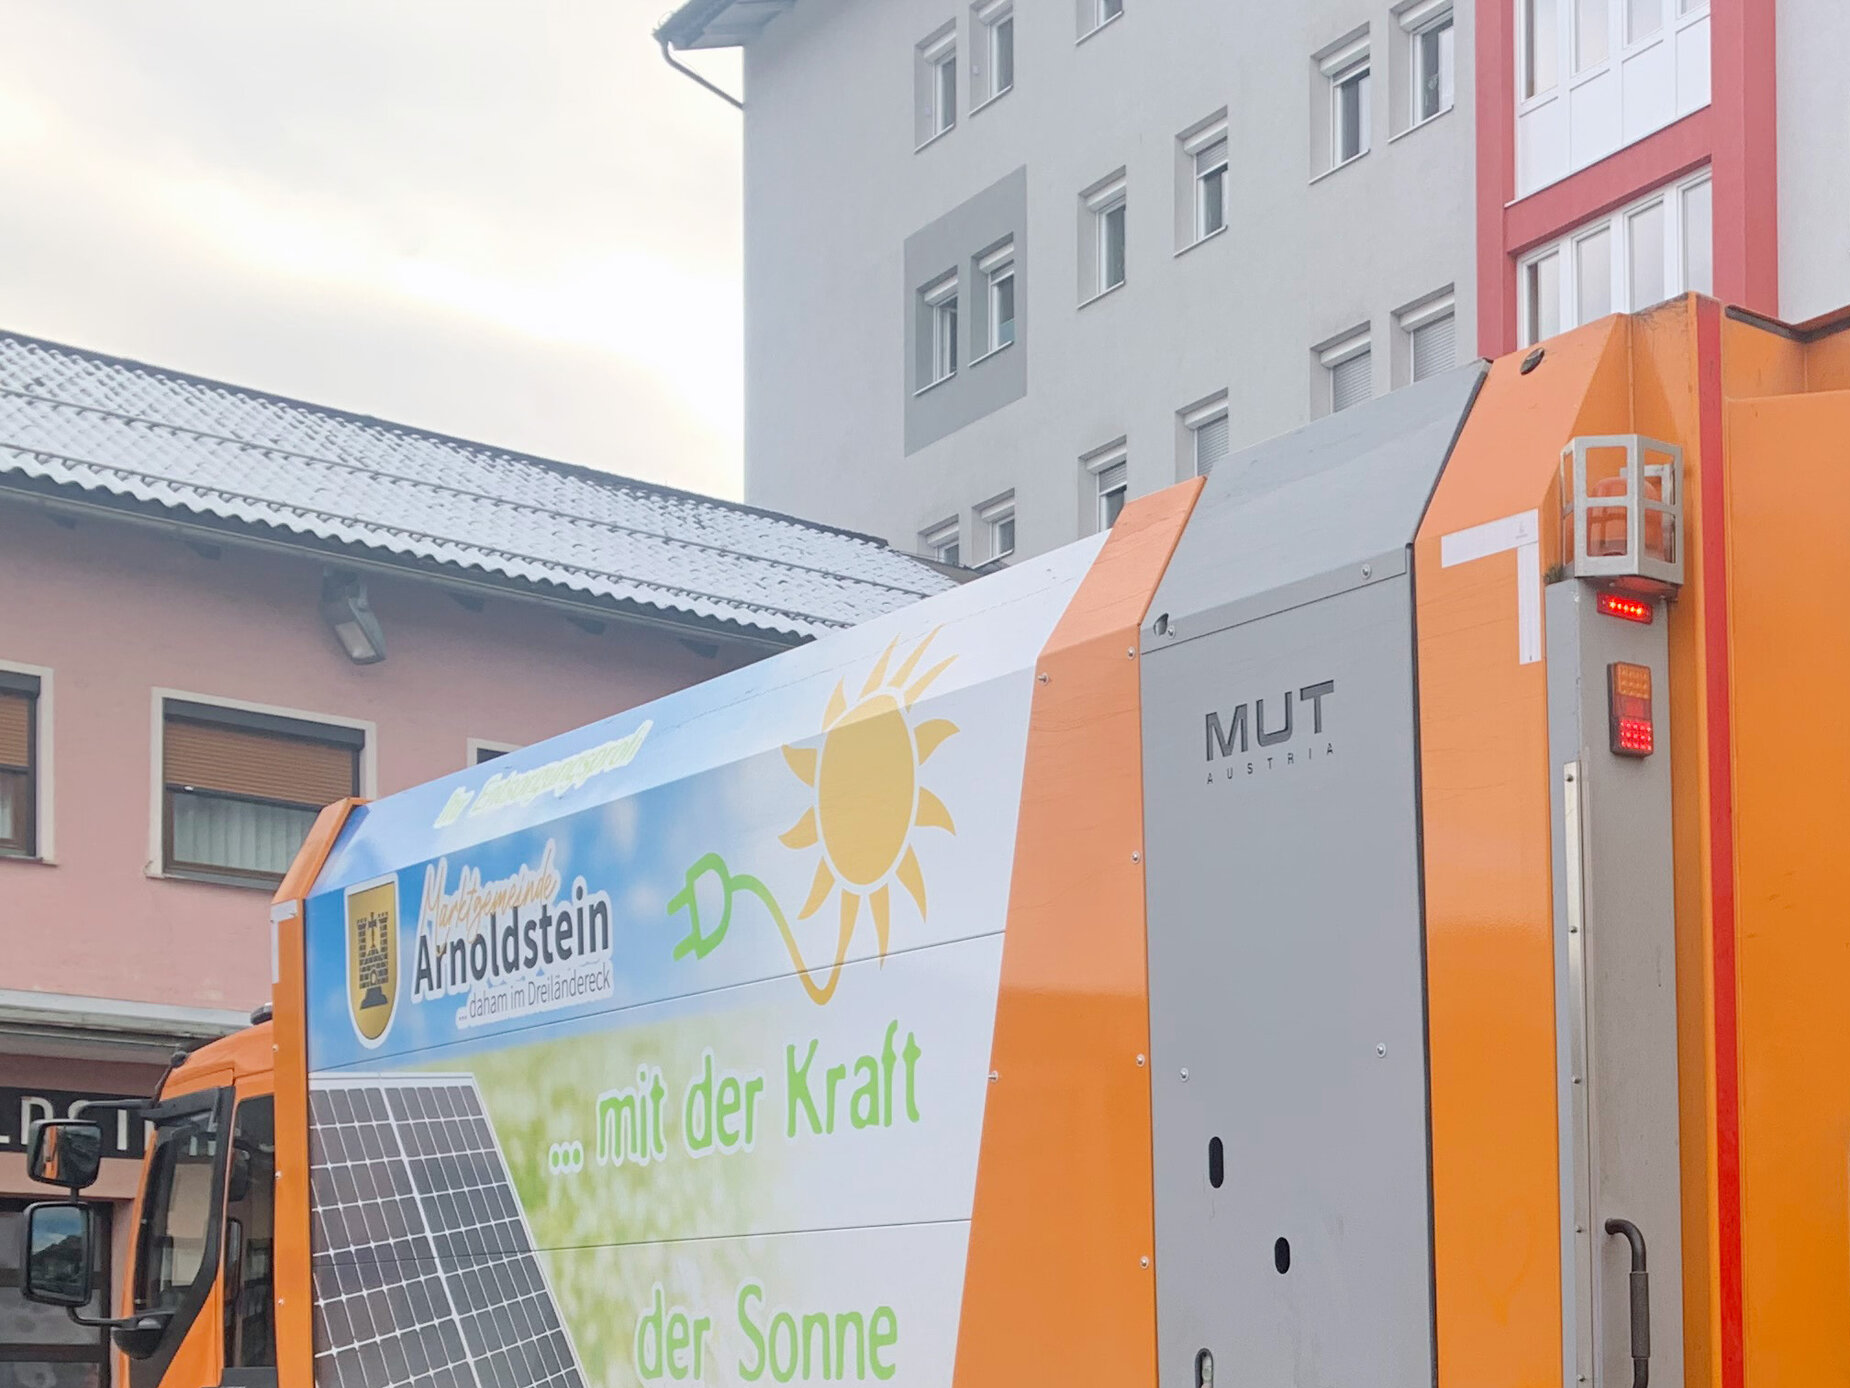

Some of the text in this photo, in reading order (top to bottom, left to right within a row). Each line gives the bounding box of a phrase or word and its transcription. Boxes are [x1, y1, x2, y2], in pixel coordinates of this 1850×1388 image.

[1205, 679, 1334, 761] MUT
[1206, 742, 1333, 784] AUSTRIA
[414, 885, 609, 995] Arnoldstein
[420, 848, 556, 954] Marktgemeinde
[469, 988, 508, 1018] daham
[510, 986, 525, 1009] im
[528, 964, 610, 1006] Dreiländereck
[599, 1069, 665, 1159] mit
[685, 1054, 763, 1150] der
[786, 1019, 922, 1138] Kraft
[638, 1284, 898, 1383] der Sonne
